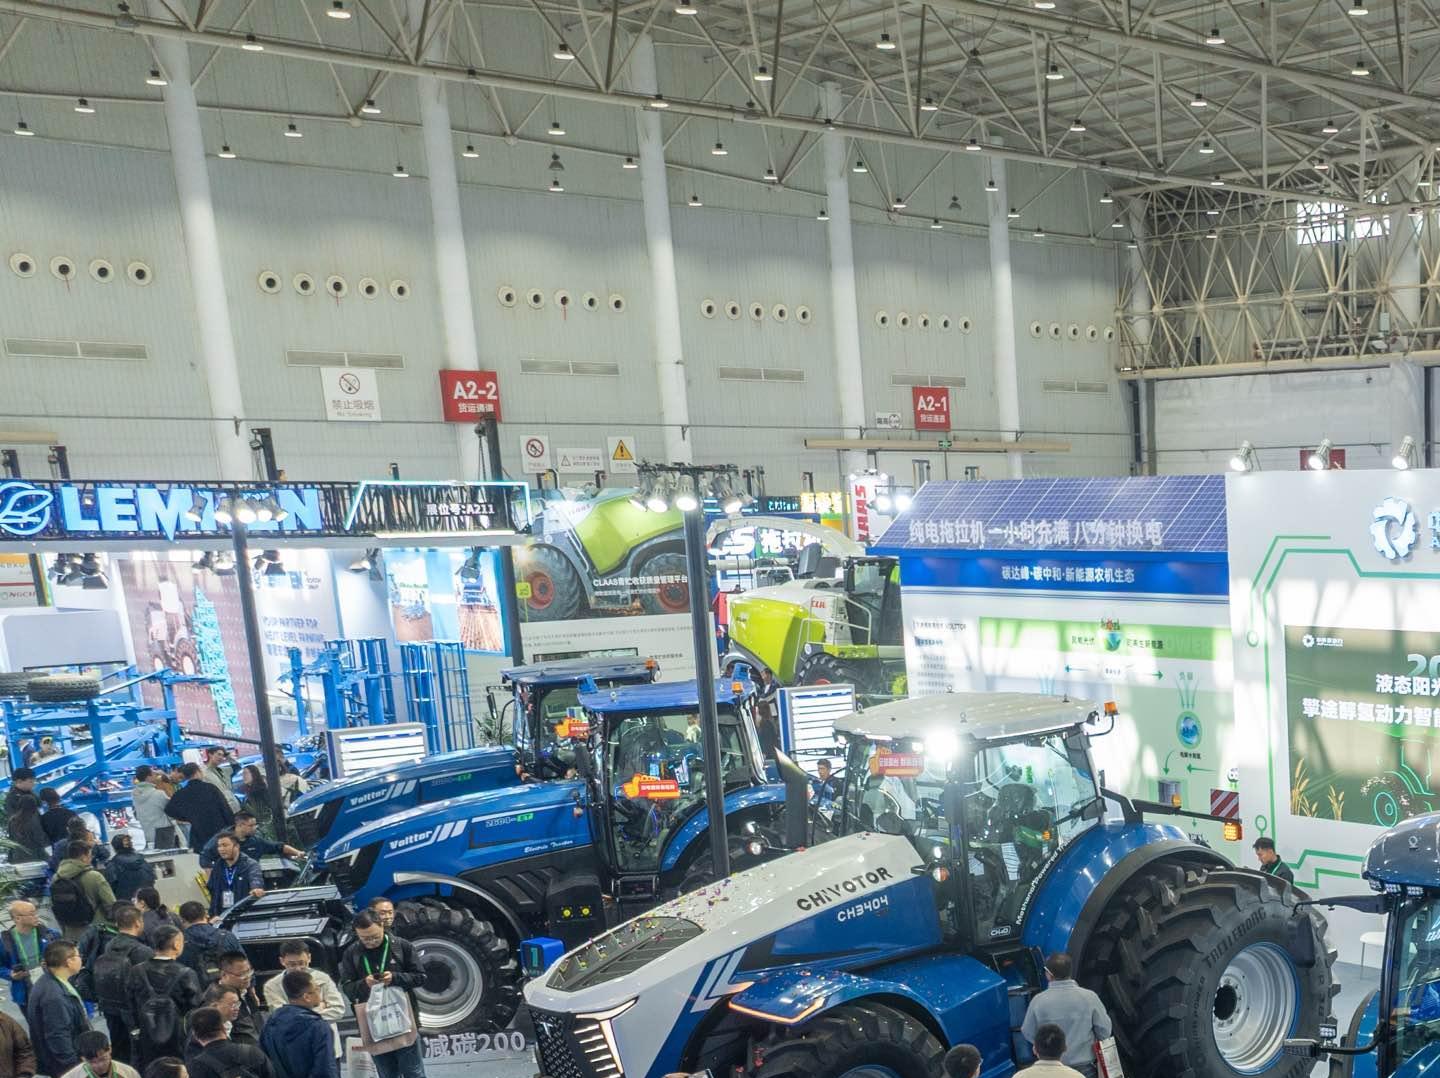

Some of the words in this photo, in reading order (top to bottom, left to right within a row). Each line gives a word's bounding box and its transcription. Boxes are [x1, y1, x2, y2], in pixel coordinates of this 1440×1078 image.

[453, 381, 498, 400] A2-2
[917, 395, 947, 412] A2-1
[909, 519, 985, 545] 纯电拖拉机
[987, 519, 1070, 545] 一小时充满
[1073, 519, 1163, 546] 八分钟换电
[837, 895, 889, 922] CH3404
[423, 1031, 526, 1058] 减碳200
